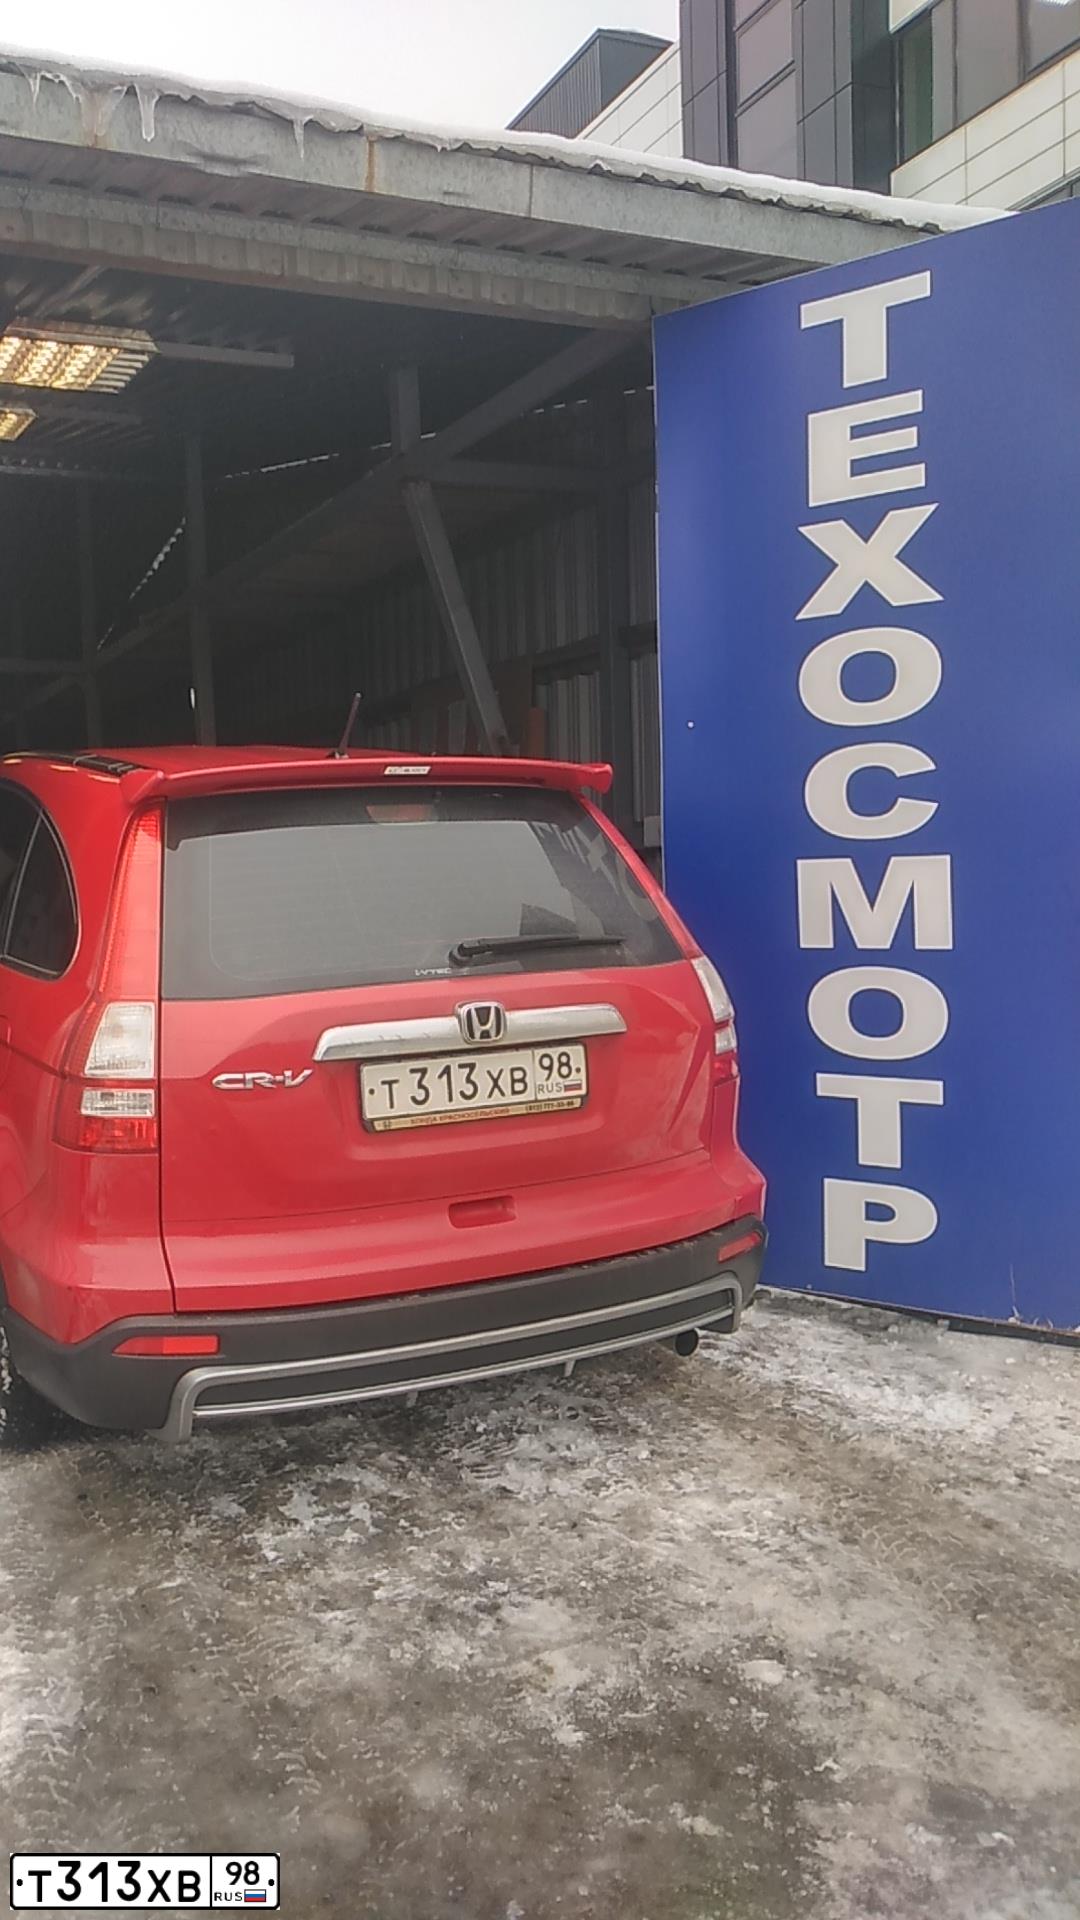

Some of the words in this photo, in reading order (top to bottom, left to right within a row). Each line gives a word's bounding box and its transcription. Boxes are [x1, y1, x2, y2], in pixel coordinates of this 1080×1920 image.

[795, 270, 953, 1271] ТЕХОСМОТР
[212, 1069, 313, 1090] CR-V
[538, 1051, 573, 1082] 98
[537, 1080, 563, 1094] RUS
